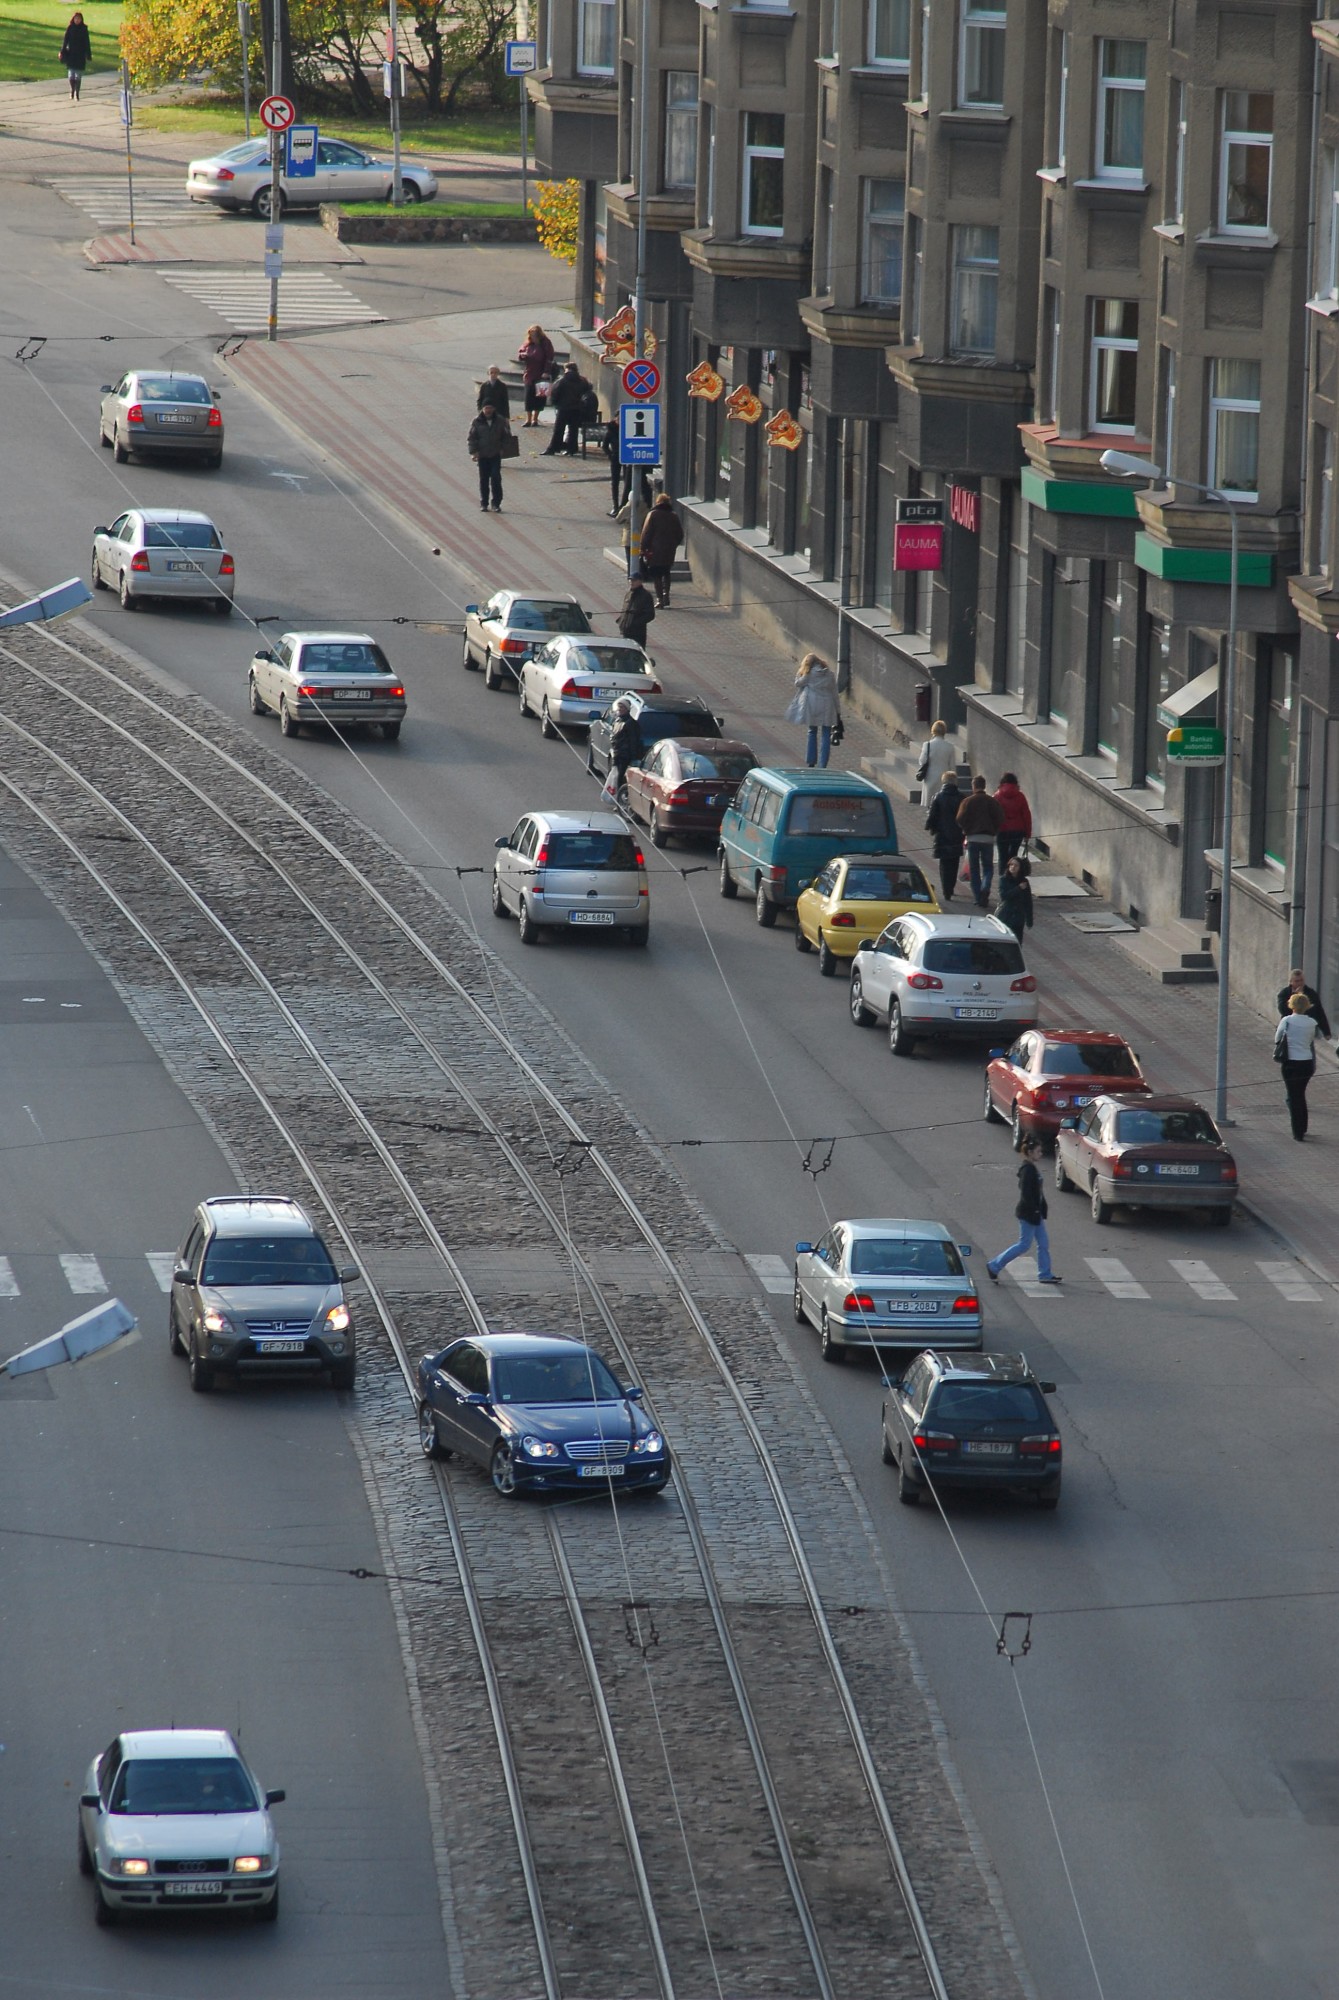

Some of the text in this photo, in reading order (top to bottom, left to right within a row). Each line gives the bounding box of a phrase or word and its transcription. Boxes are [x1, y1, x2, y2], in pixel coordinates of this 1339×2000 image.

[632, 450, 654, 459] 100m
[906, 505, 937, 517] pta
[899, 538, 939, 549] LAUMA
[1190, 735, 1213, 743] Bankas
[896, 1301, 936, 1311] FB-2084
[262, 1342, 303, 1351] GF-7918
[172, 1882, 221, 1893] EH-4449
